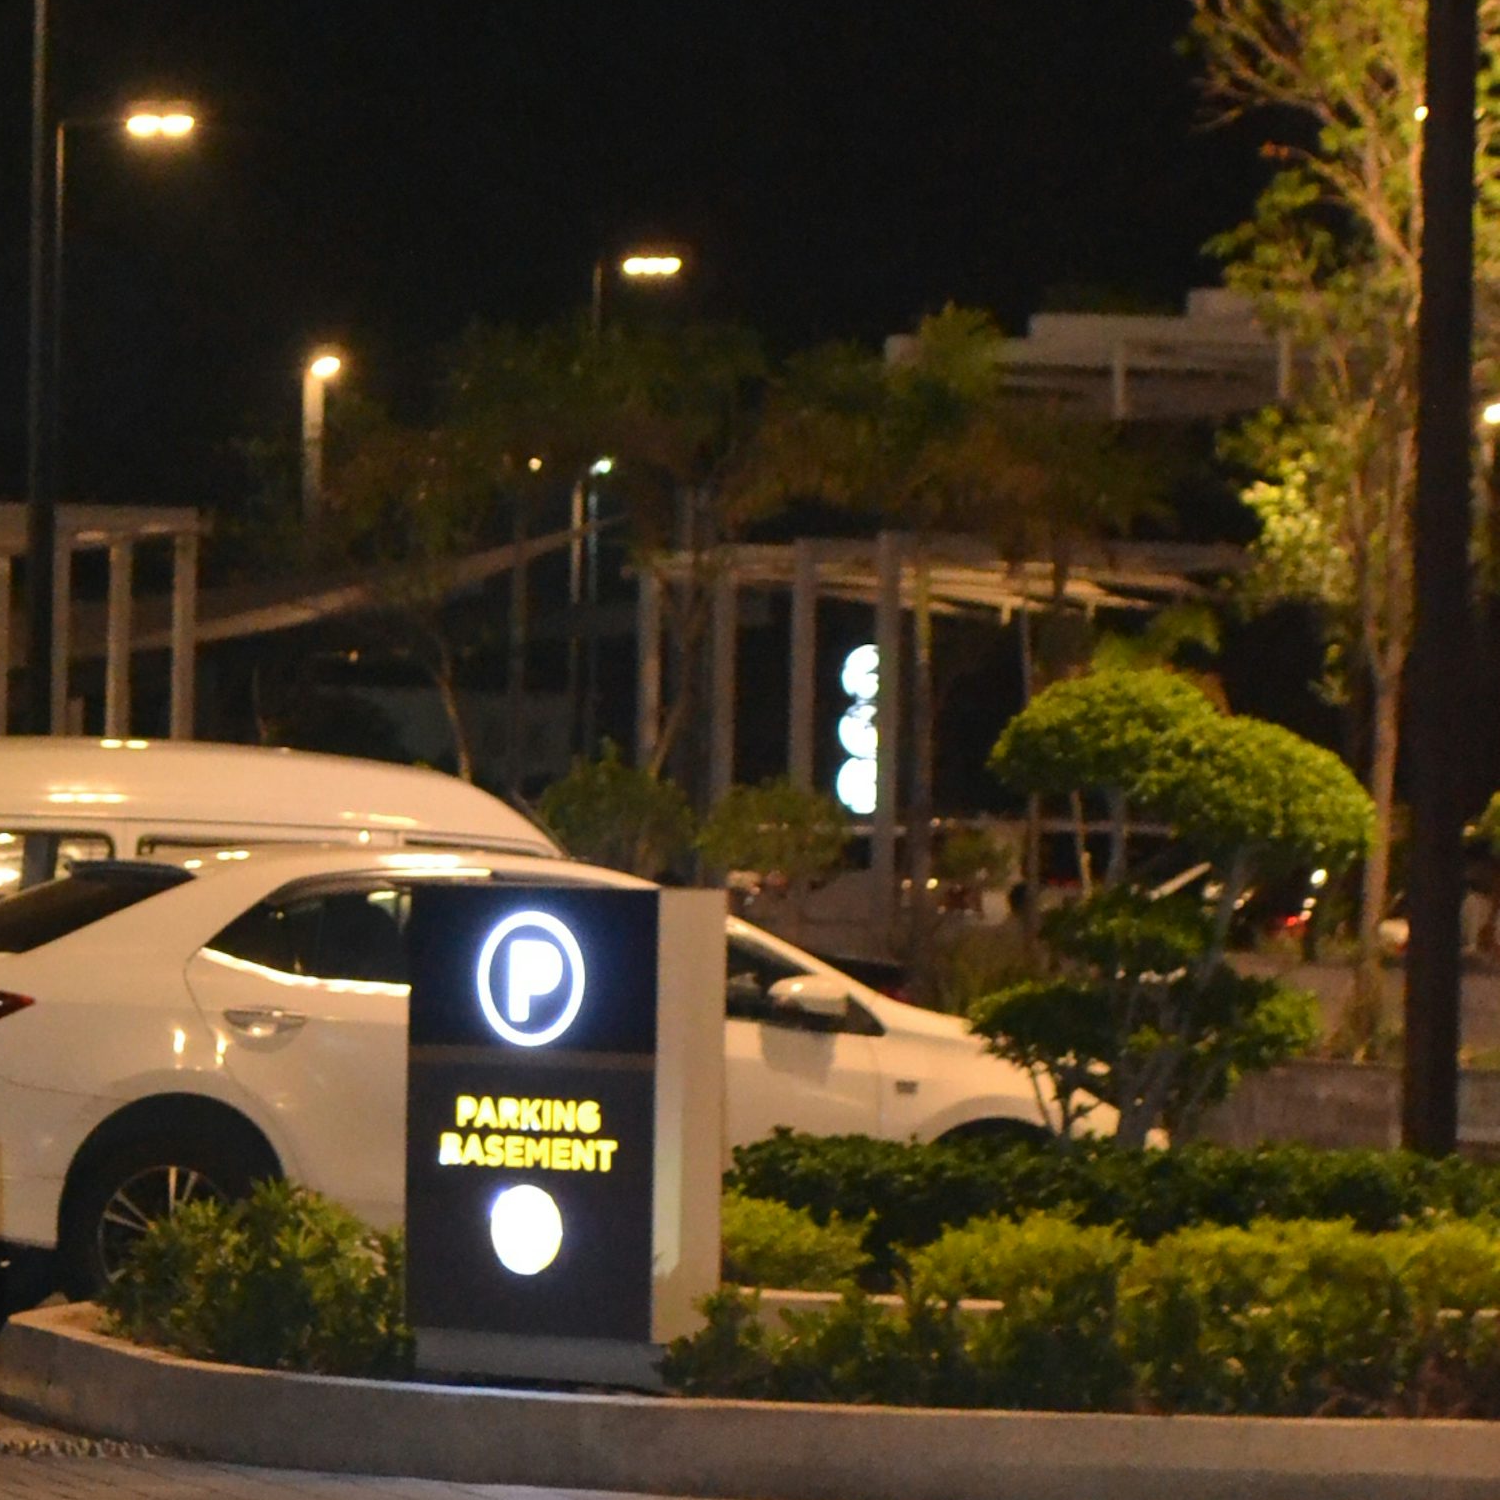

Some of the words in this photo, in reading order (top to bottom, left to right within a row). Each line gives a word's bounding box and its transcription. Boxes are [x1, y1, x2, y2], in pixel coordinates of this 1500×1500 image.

[509, 939, 563, 1022] P
[456, 1095, 602, 1134] PARKING
[438, 1132, 618, 1172] BASEMENT
